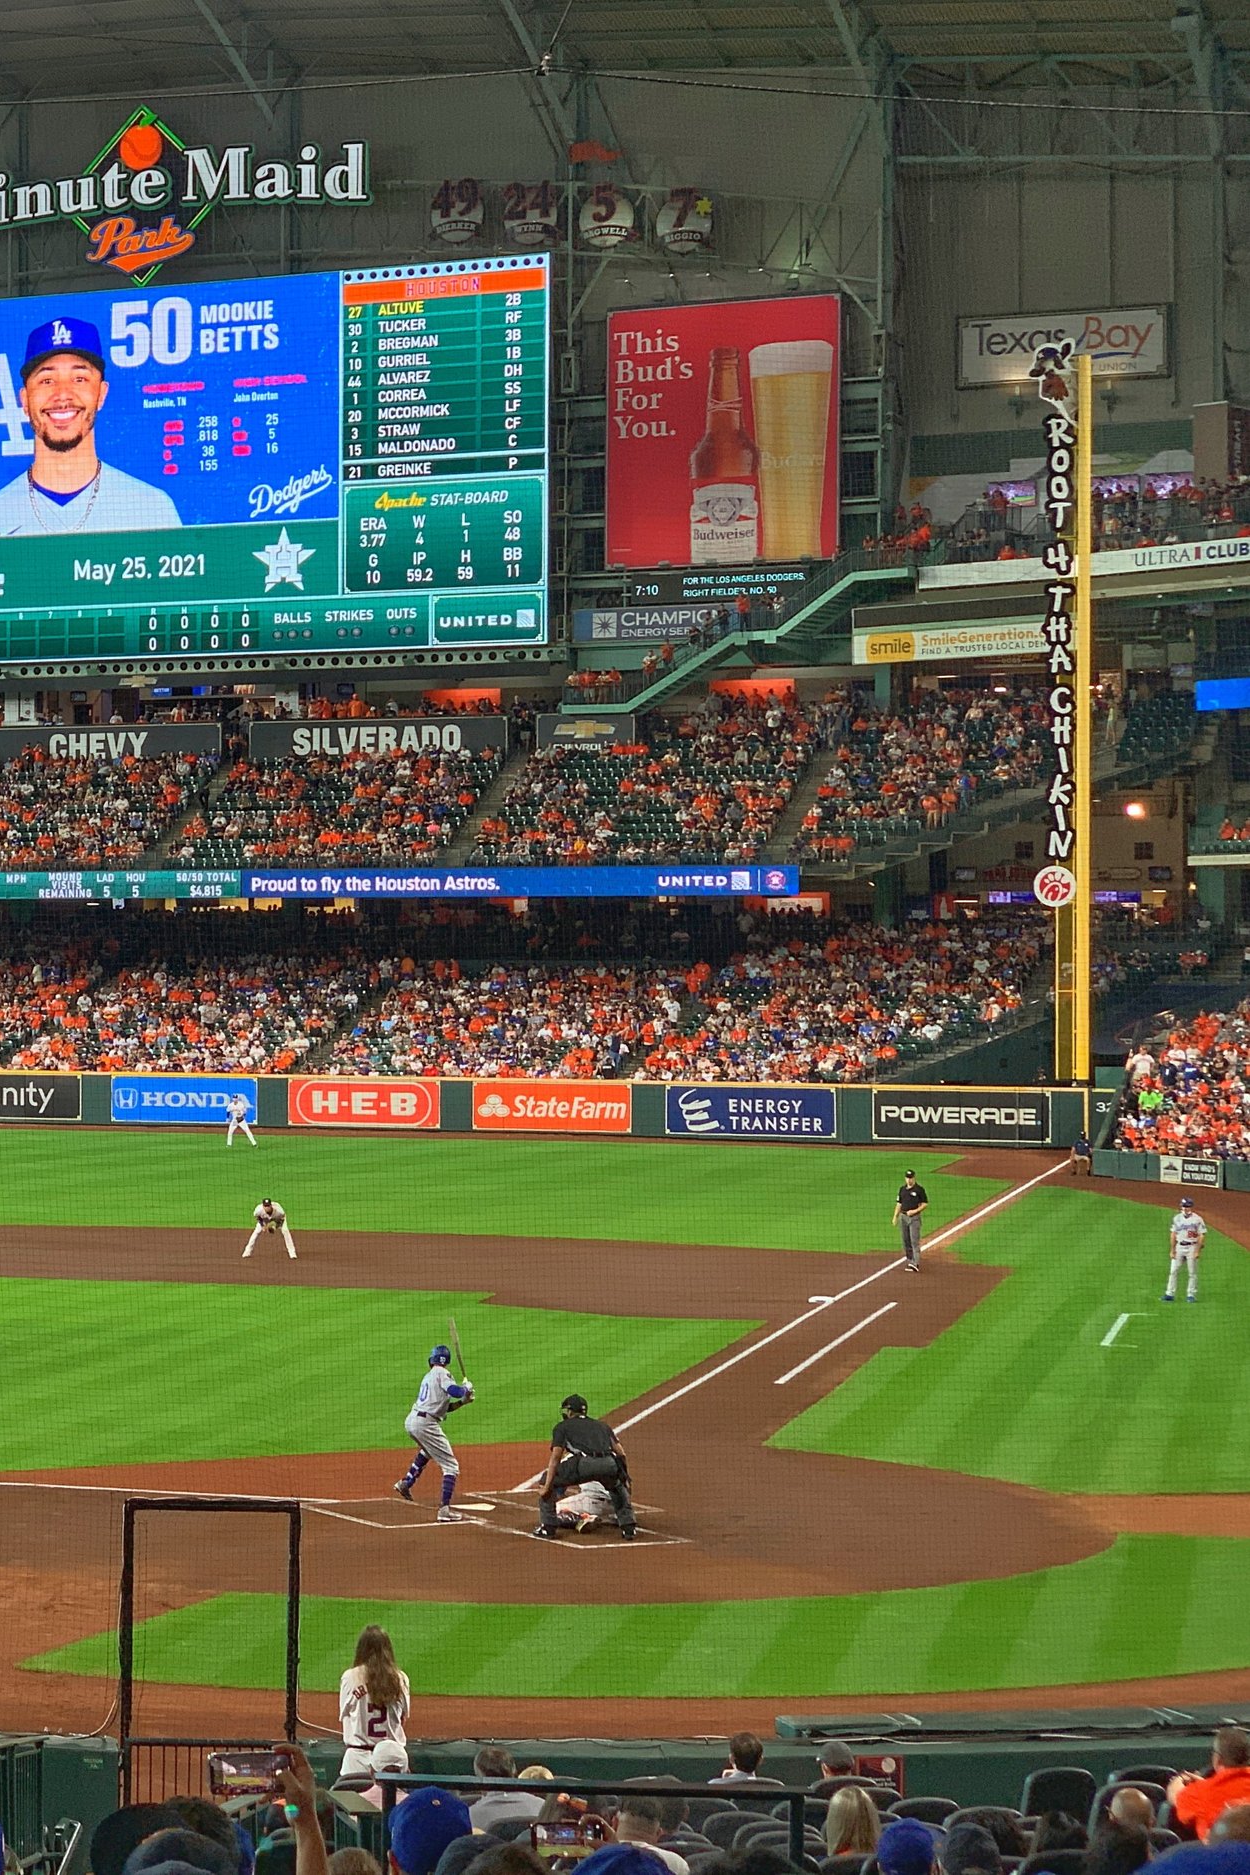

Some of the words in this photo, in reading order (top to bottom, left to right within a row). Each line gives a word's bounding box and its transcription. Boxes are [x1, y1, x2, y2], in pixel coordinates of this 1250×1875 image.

[182, 142, 368, 202] Maid
[86, 215, 193, 271] Park
[406, 277, 481, 296] HOUSTON
[200, 300, 274, 325] MOOKIE
[378, 301, 424, 316] ALTUVE
[110, 297, 193, 368] 50
[378, 318, 426, 333] TUCKER
[200, 323, 279, 355] BETTS
[378, 335, 439, 351] BREGMAN
[614, 328, 680, 356] This
[1085, 316, 1154, 358] Bay
[378, 353, 431, 368] GURRIEL
[615, 354, 694, 384] Bud's
[1100, 361, 1137, 372] UNION
[378, 370, 431, 385] ALVAREZ
[177, 397, 186, 406] TN
[233, 393, 250, 403] John
[252, 391, 279, 402] Overton
[378, 388, 427, 403] CORREA
[614, 387, 663, 412] For
[378, 404, 450, 420] MCCORMICK
[378, 423, 421, 437] STRAW
[613, 415, 677, 439] You.
[378, 438, 456, 454] MALDONADO
[378, 462, 432, 477] GREINKE
[1048, 418, 1072, 529] ROOT
[248, 463, 333, 517] Dodgers
[374, 491, 427, 510] Apache
[430, 489, 509, 507] STAT-BOARD
[692, 527, 755, 542] Budweiser
[1047, 546, 1072, 574] 4
[1134, 546, 1191, 567] ULTRA
[1206, 542, 1250, 559] CLUB
[74, 557, 113, 585] May
[158, 553, 206, 577] 2021
[683, 577, 698, 585] FOR
[700, 576, 714, 584] THE
[715, 576, 730, 584] LOS
[731, 574, 765, 583] ANGELES
[766, 572, 806, 582] DODGERS,
[635, 585, 659, 596] 7:10
[682, 588, 709, 597] RIGHT
[749, 586, 765, 595] NO.
[274, 611, 312, 625] BALLS
[324, 608, 374, 622] STRIKES
[386, 607, 417, 620] OUTS
[439, 613, 513, 628] UNITED
[621, 627, 667, 637] ENERGY
[1047, 585, 1072, 675] THA
[870, 638, 911, 655] smile
[921, 648, 941, 656] FIND
[954, 644, 992, 654] TRUSTED
[996, 642, 1026, 651] LOCAL
[1028, 640, 1048, 649] DEN
[49, 732, 148, 760] CHEVY
[292, 724, 461, 756] SILVERADO
[1048, 686, 1073, 858] CHIKIN
[6, 873, 27, 884] MPH
[176, 872, 203, 882] 50/50
[206, 871, 237, 882] TOTAL
[250, 875, 297, 893] Proud
[300, 877, 318, 892] to
[320, 875, 343, 896] fly
[345, 875, 372, 892] the
[374, 874, 440, 892] Houston
[443, 874, 501, 892] Astros.
[657, 874, 728, 888] UNITED
[140, 1091, 255, 1110] HONDA
[310, 1090, 419, 1117] H-E-B
[728, 1098, 803, 1115] ENERGY
[729, 1116, 824, 1133] TRANSFER
[880, 1105, 1037, 1126] POWERADE
[368, 1703, 388, 1737] 2
